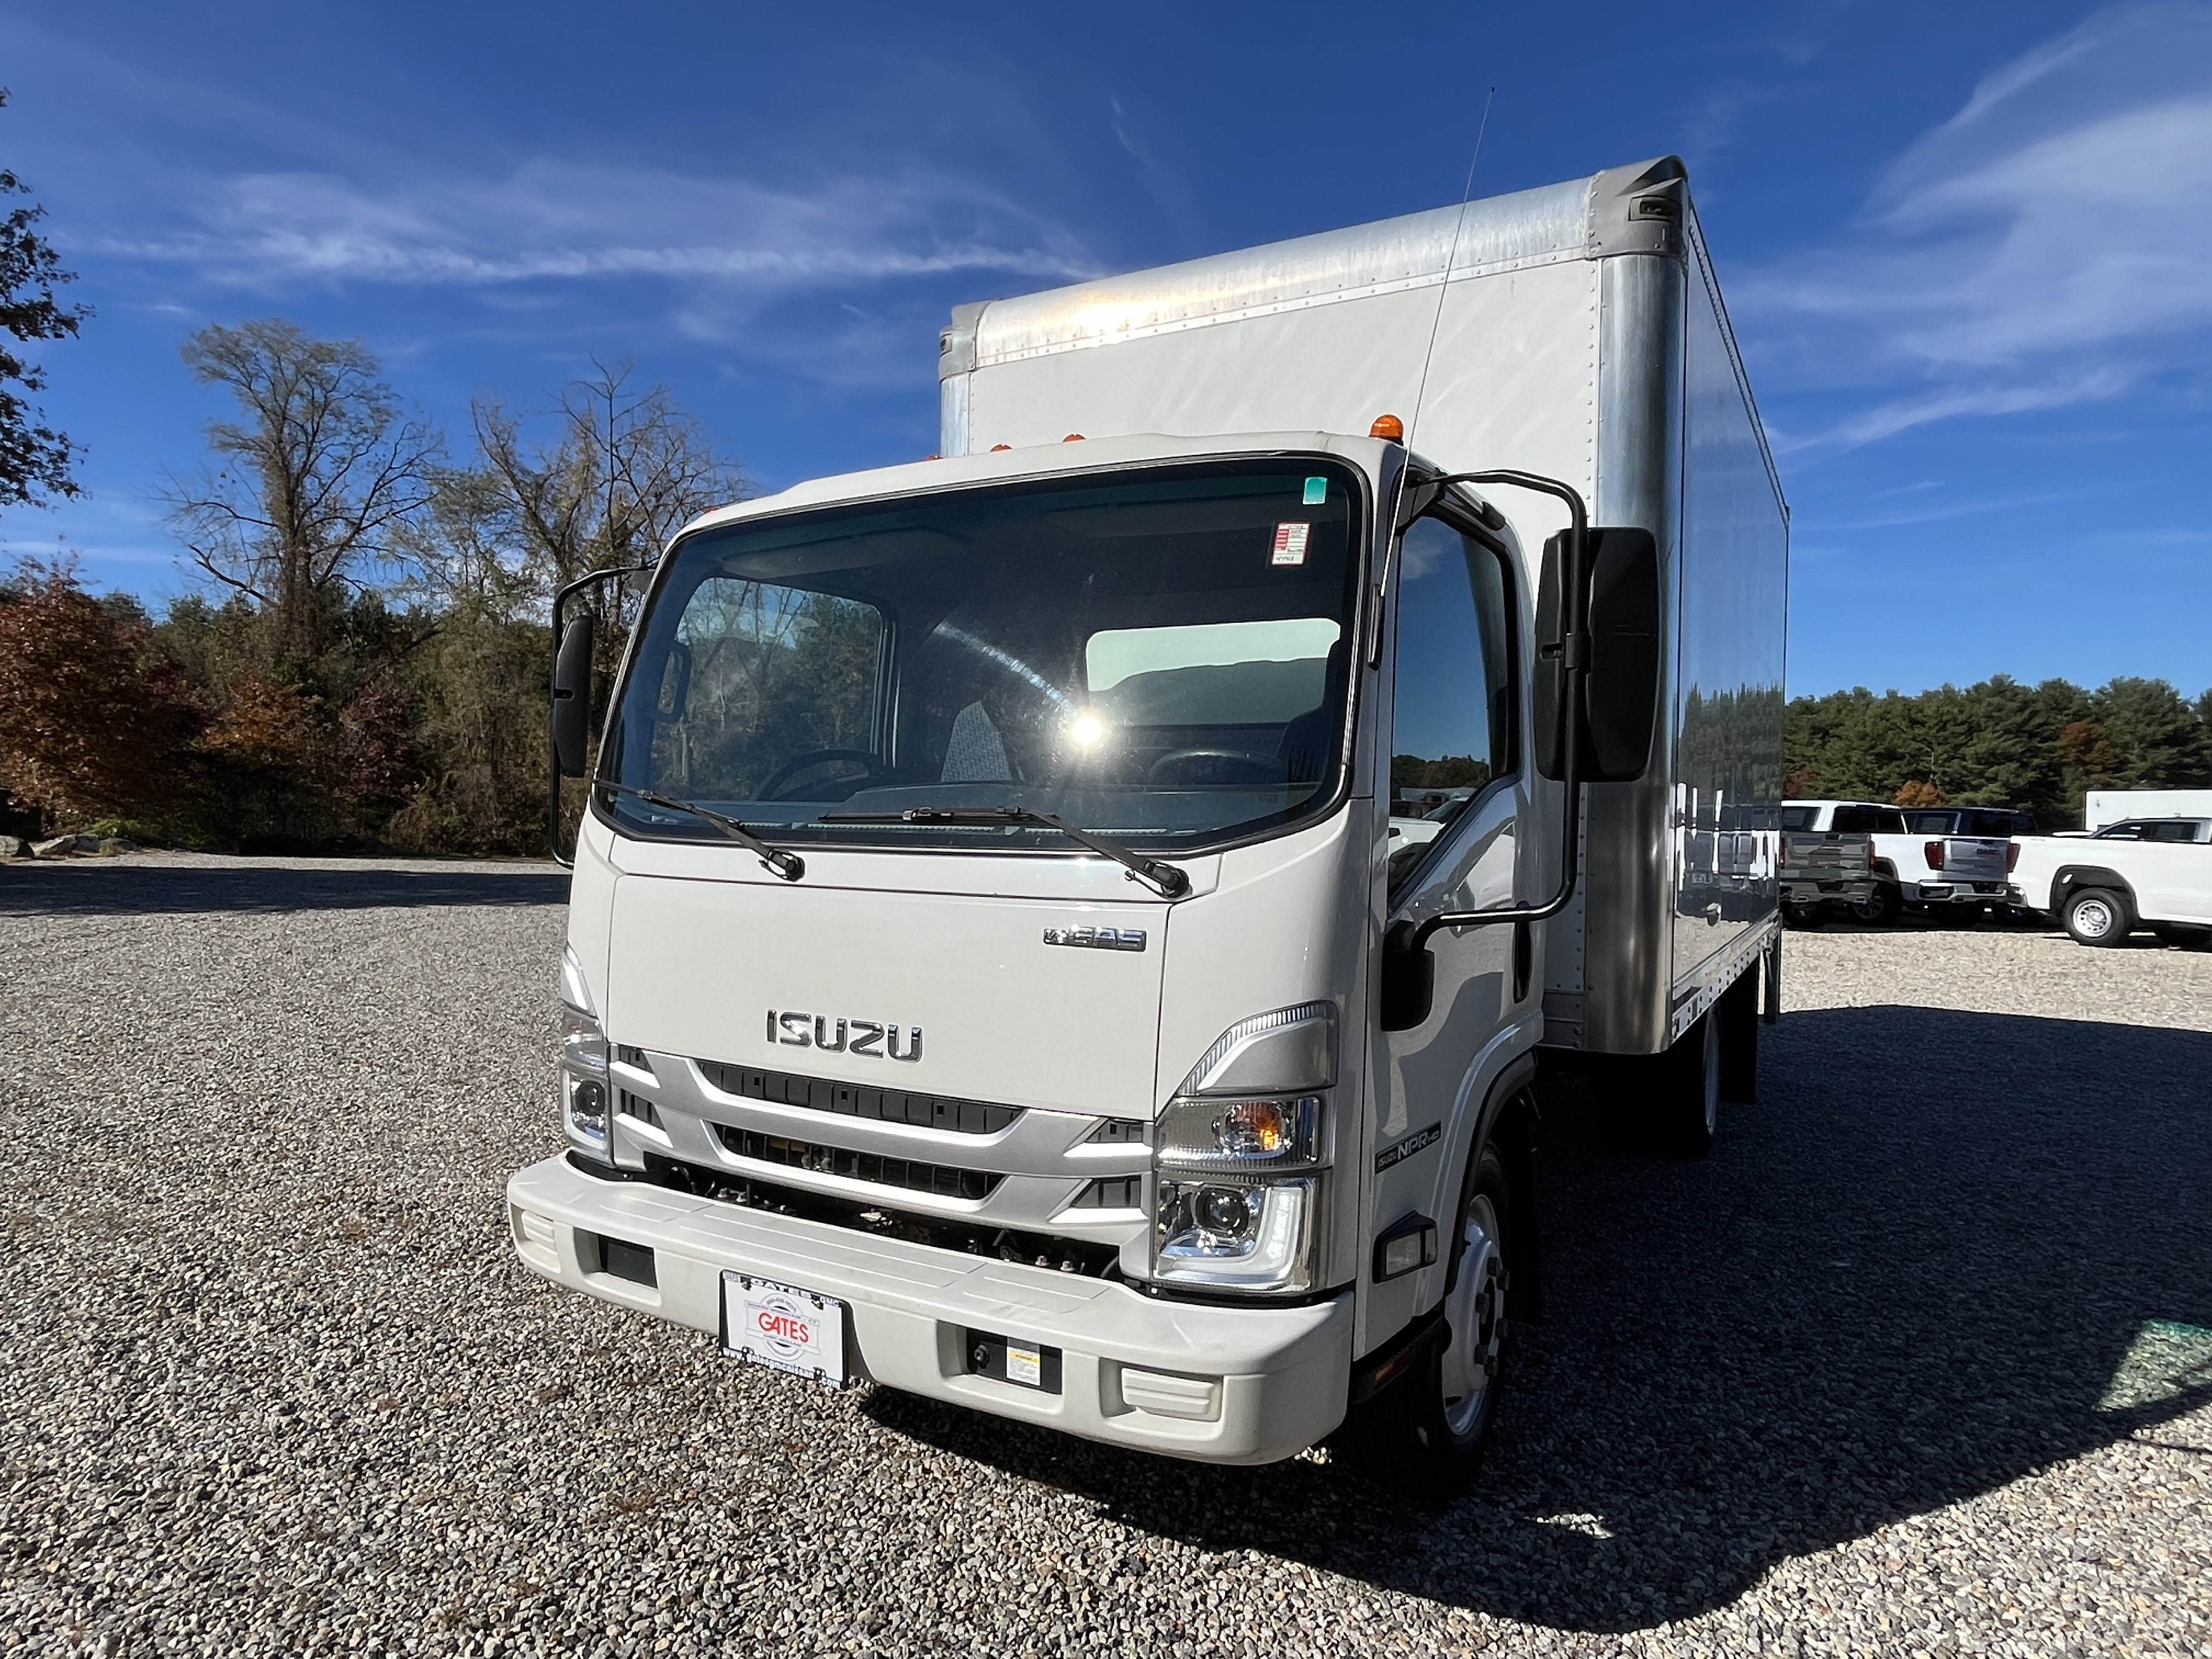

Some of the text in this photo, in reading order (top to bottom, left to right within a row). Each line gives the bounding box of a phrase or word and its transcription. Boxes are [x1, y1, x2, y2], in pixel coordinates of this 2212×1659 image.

[1070, 924, 1143, 950] GAS
[767, 1009, 923, 1062] ISUZU
[1397, 1131, 1428, 1160] NPR
[759, 1312, 809, 1343] GATES
